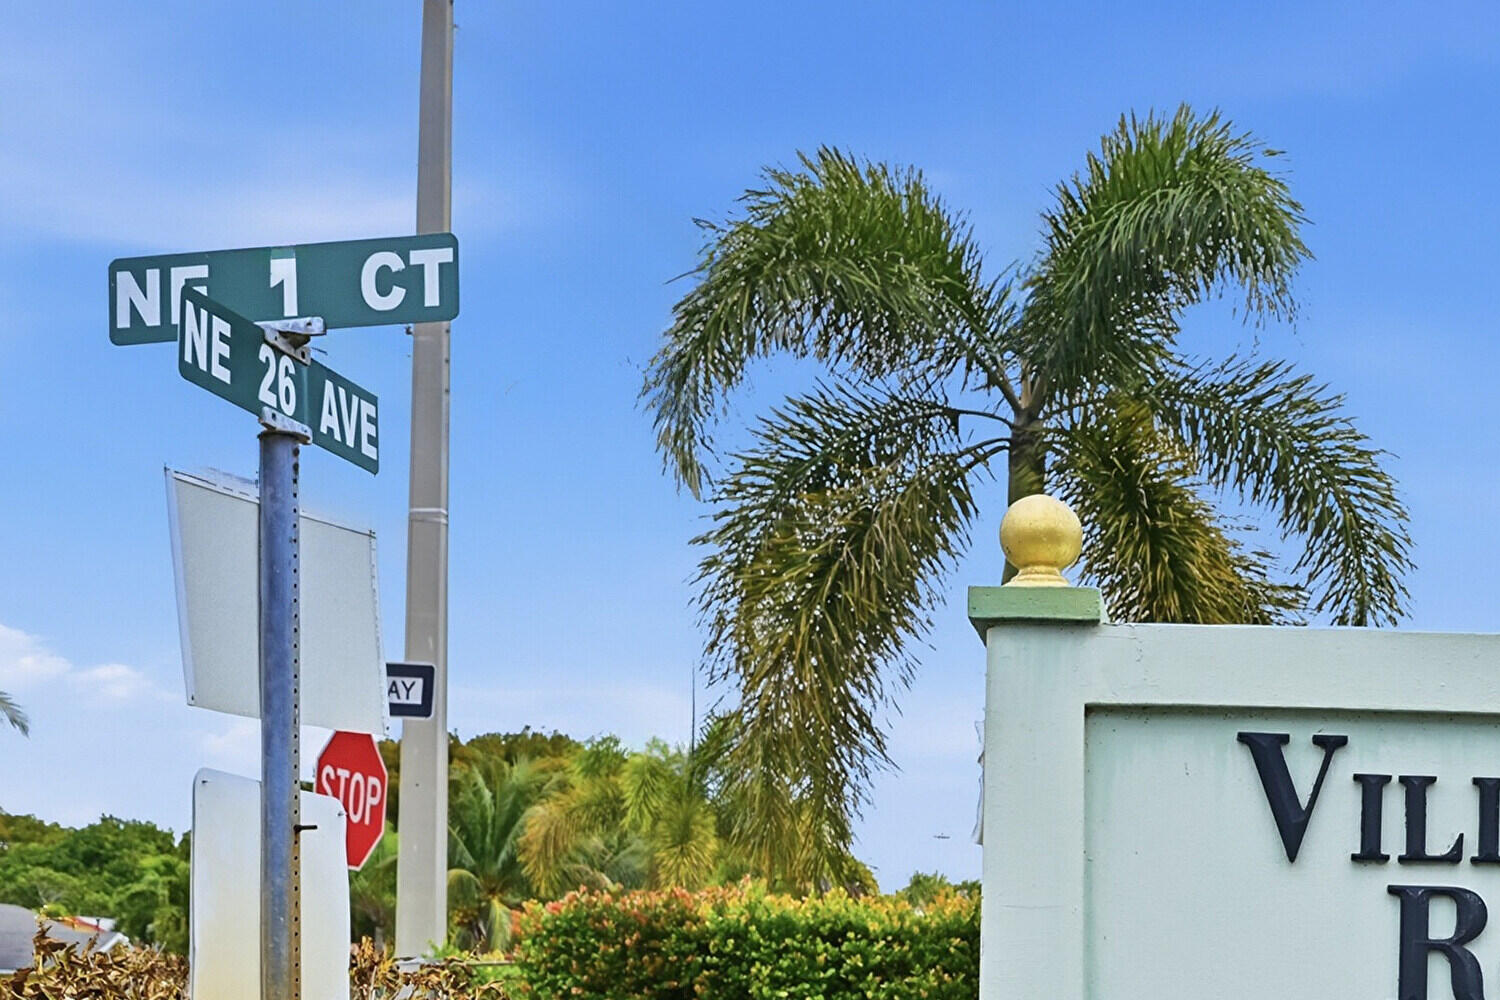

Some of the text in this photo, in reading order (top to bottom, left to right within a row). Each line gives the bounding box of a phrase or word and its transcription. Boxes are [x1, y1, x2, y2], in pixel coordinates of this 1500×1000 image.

[270, 258, 297, 317] 1
[360, 247, 454, 312] CT
[184, 299, 378, 460] NE 26 AVE
[388, 680, 416, 700] AY
[321, 764, 382, 826] STOP
